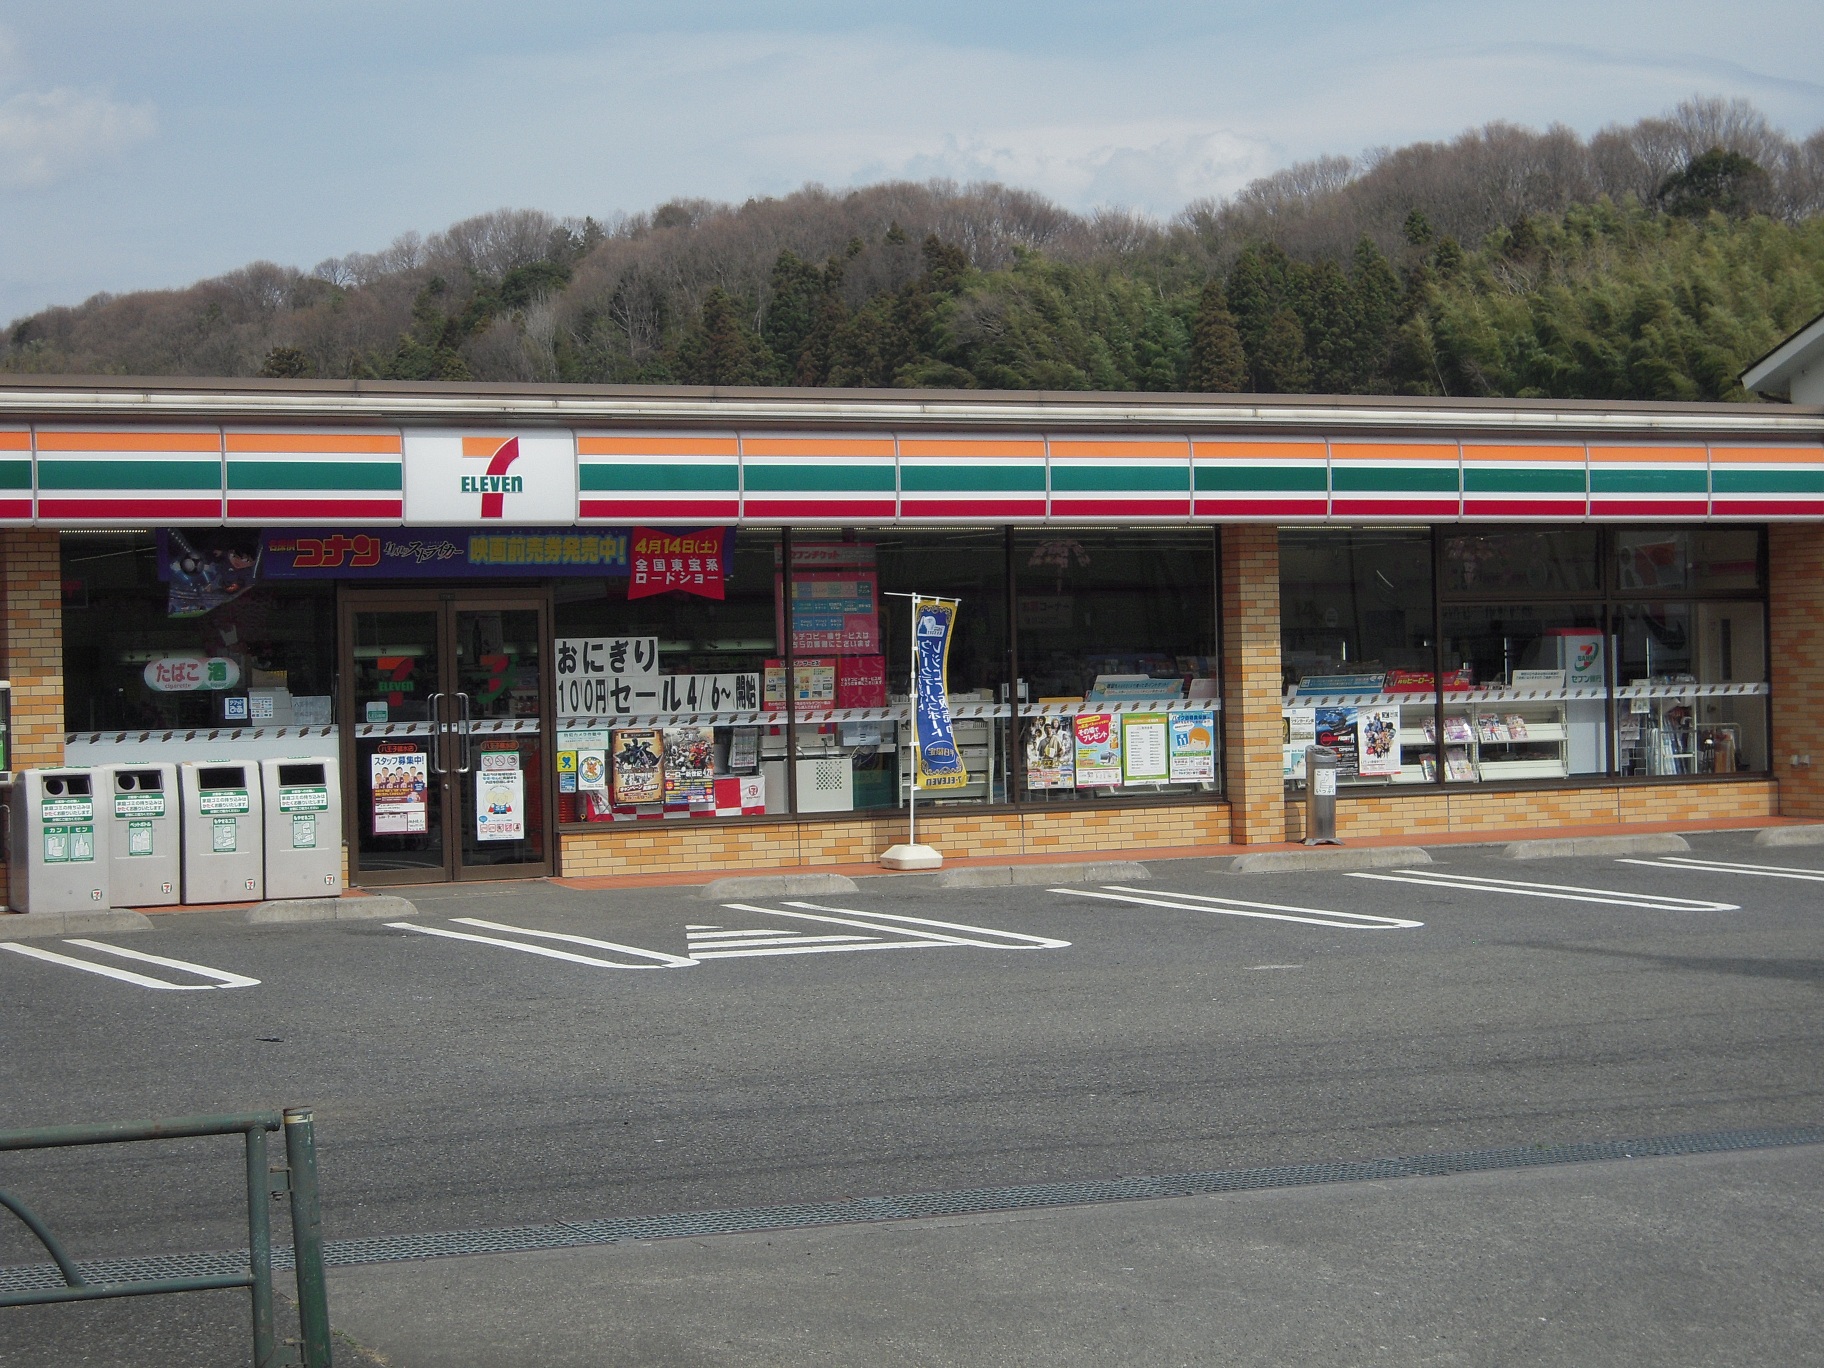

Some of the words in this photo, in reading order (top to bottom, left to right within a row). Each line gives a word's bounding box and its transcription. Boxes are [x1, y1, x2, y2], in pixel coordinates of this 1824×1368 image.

[461, 436, 519, 517] 7
[292, 534, 380, 567] コナン
[635, 538, 718, 554] 4月14日(土)
[635, 559, 718, 571] 全国東宝系
[635, 572, 718, 584] ロードショー
[557, 639, 656, 675] おにぎり
[156, 662, 200, 682] たばこ
[207, 661, 227, 682] 酒
[1571, 675, 1602, 683] セブン銀行
[229, 705, 244, 714] ぴあ
[1077, 727, 1099, 737] その場で
[1082, 731, 1108, 742] プレゼント
[374, 755, 425, 765] スタッフ募集中!
